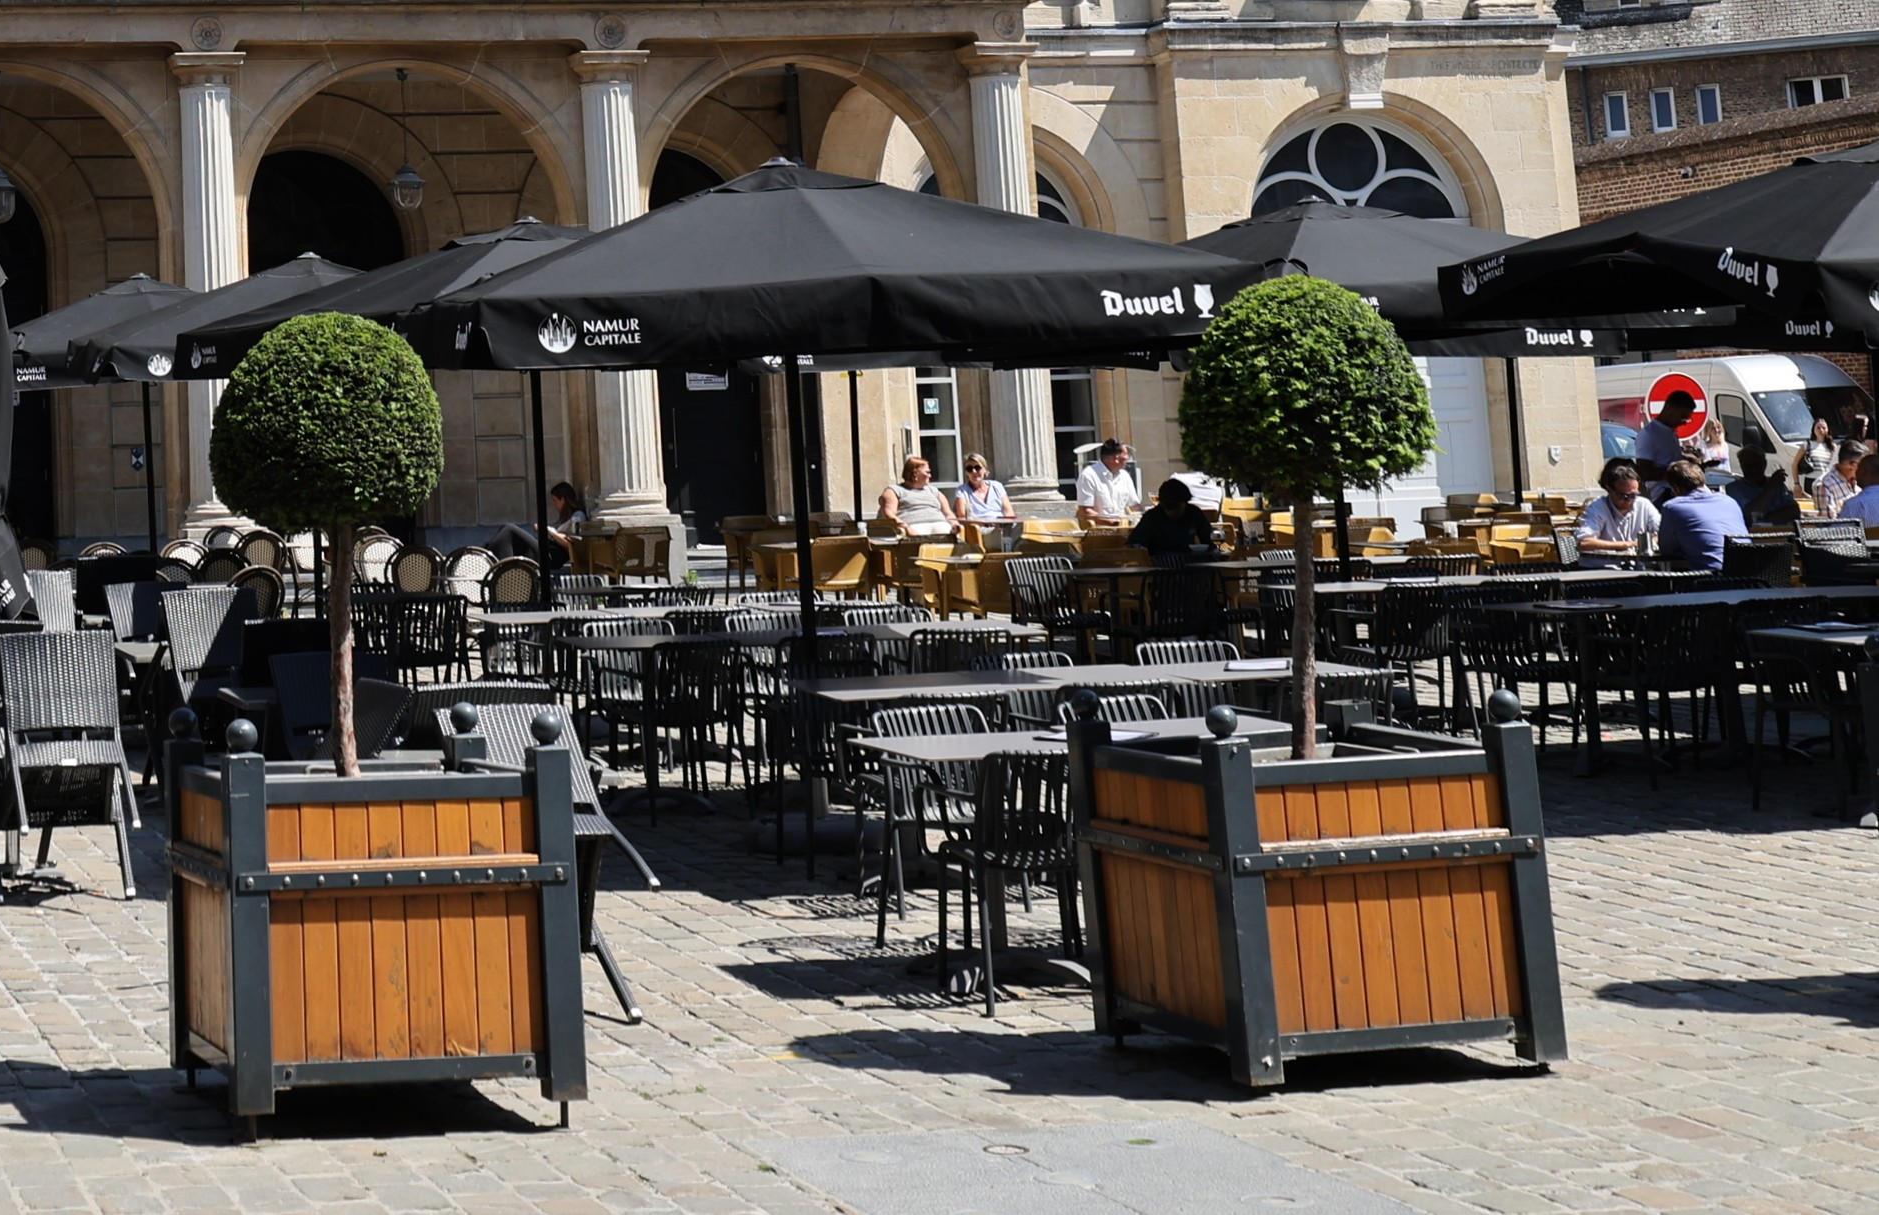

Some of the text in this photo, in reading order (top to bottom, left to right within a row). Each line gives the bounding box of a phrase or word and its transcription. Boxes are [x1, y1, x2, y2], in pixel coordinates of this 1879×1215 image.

[1717, 246, 1759, 286] Duvel
[1100, 286, 1185, 317] Duvel
[583, 318, 640, 333] NAMUR
[1785, 320, 1821, 336] Duvel
[584, 333, 642, 346] CAPITALE
[1525, 327, 1575, 345] Duvel
[16, 366, 47, 375] NAMUR
